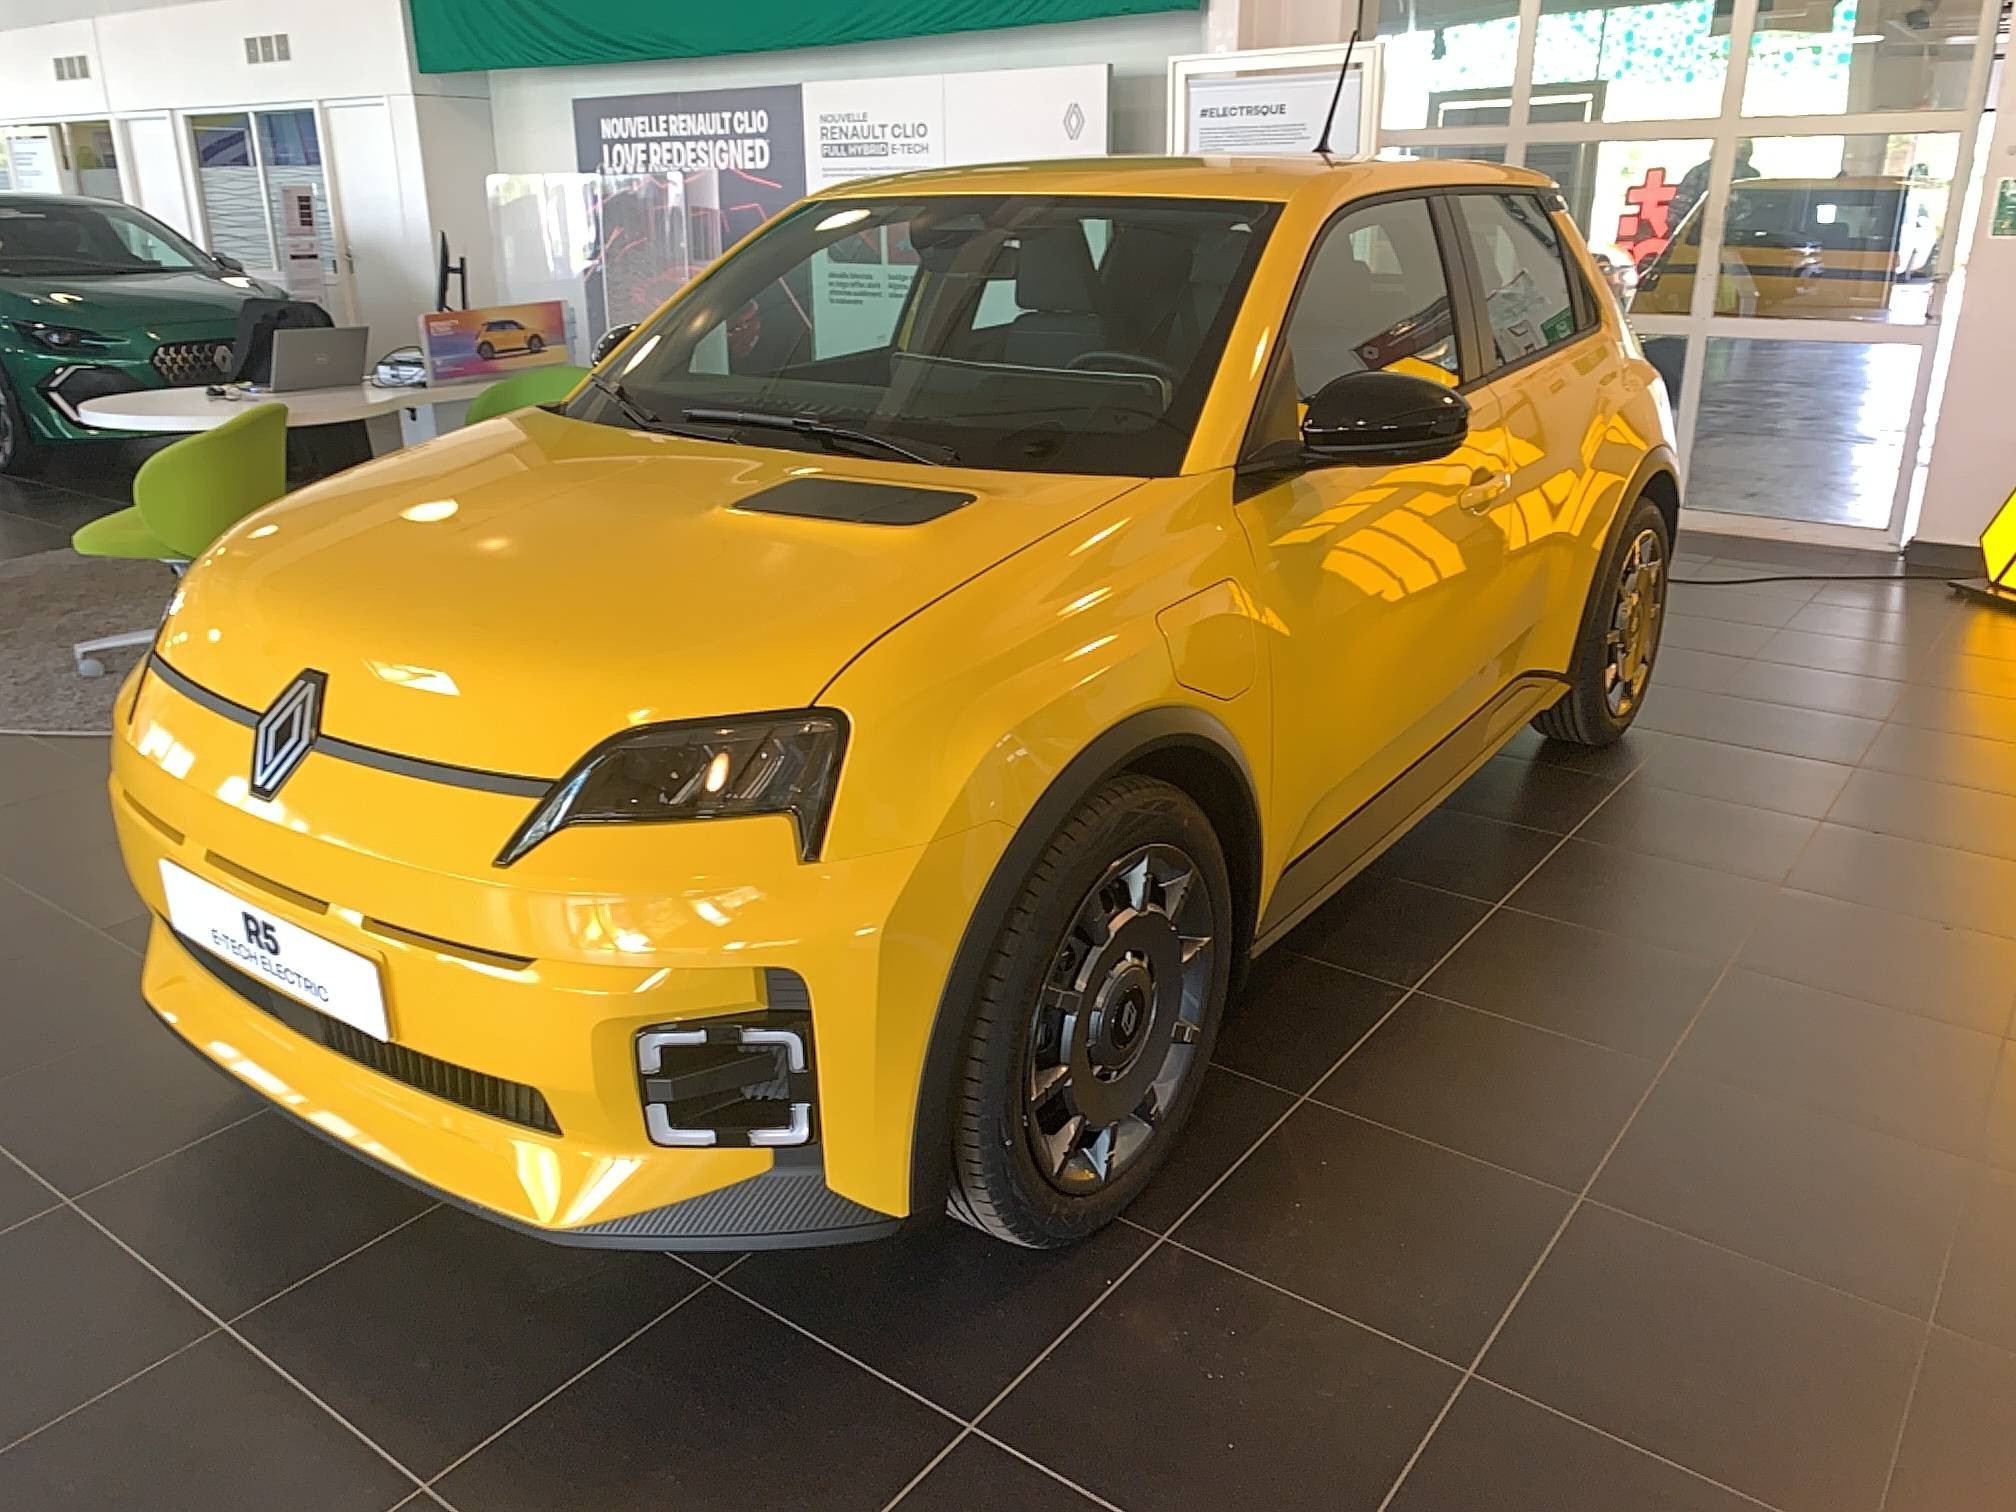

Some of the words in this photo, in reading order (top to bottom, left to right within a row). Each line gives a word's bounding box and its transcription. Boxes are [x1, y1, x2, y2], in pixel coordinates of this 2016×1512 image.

[600, 115, 668, 139] NOUVELLE
[669, 111, 732, 137] RENAULT
[733, 109, 769, 133] CLIO
[819, 112, 869, 124] NOUVELLE
[820, 124, 888, 140] RENAULT
[890, 122, 929, 139] CLIO
[602, 143, 648, 174] LOVE
[649, 138, 771, 172] REDESIGNED
[822, 144, 847, 157] FULL
[890, 143, 930, 155] E-TECH
[241, 911, 280, 956] R5
[211, 928, 259, 966] E-TECH
[259, 955, 329, 1002] ELECTRIC
